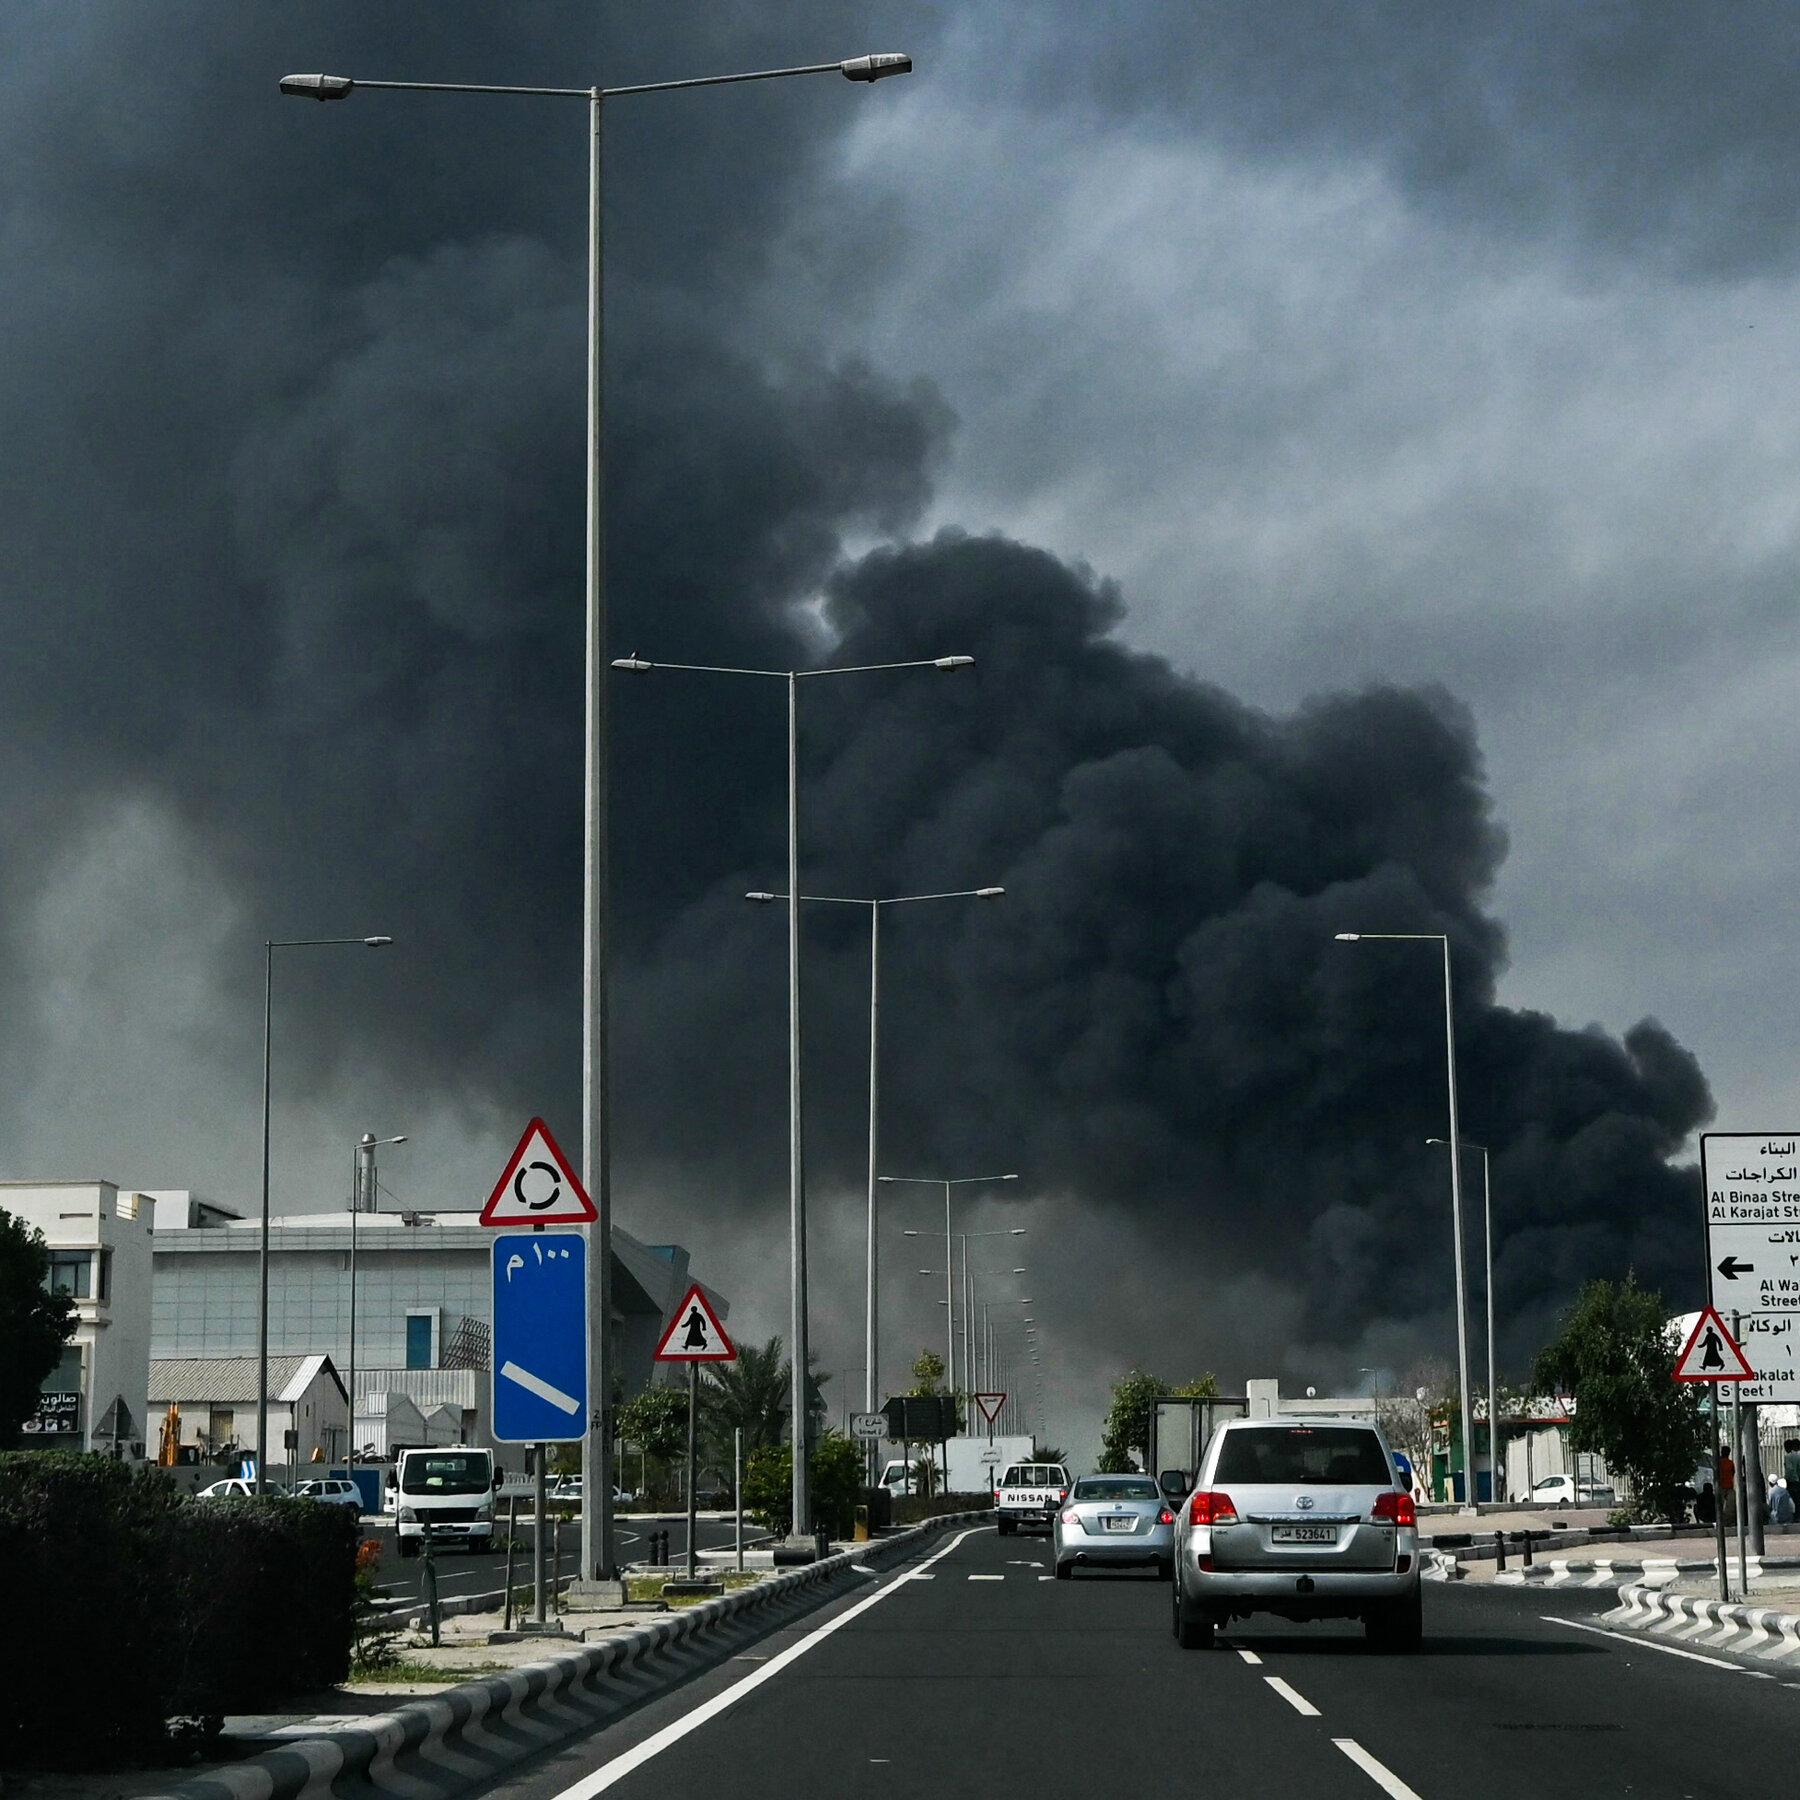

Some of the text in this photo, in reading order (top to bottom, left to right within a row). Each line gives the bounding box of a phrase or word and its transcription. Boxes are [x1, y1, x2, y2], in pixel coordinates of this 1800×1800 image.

[1760, 1142, 1795, 1158] البناء
[1726, 1167, 1797, 1183] الكراجات
[1711, 1191, 1725, 1203] Al
[1730, 1191, 1767, 1203] Binaa
[1712, 1206, 1800, 1220] Al Karajat St
[507, 1255, 524, 1283] م
[1760, 1279, 1800, 1291] Al Wa
[1753, 1368, 1795, 1381] akalat
[1768, 1384, 1774, 1396] 1
[41, 1393, 77, 1405] صالون
[1007, 1494, 1053, 1502] NISSAN
[1295, 1529, 1331, 1540] 523641
